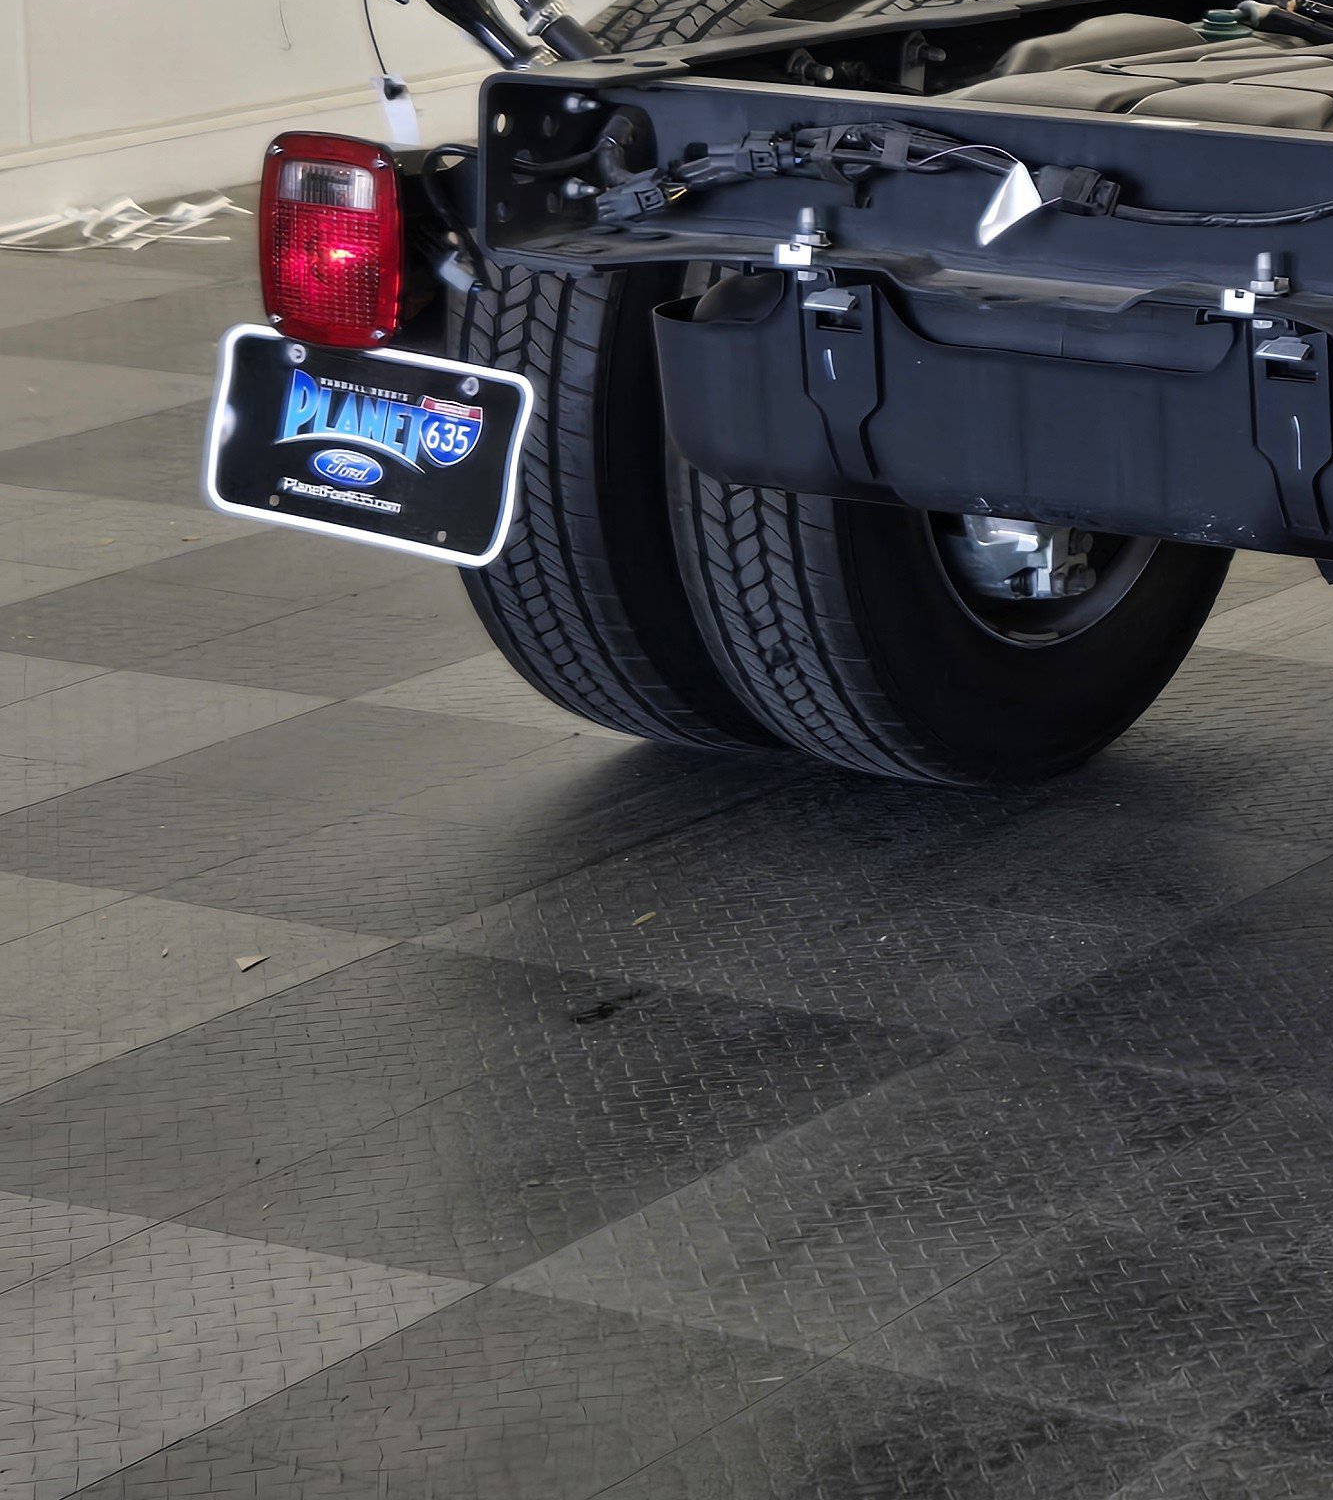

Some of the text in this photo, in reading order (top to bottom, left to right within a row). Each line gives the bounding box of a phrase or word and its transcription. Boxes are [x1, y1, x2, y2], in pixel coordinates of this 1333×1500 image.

[282, 369, 429, 463] PLANET
[426, 421, 471, 454] 635
[325, 455, 370, 484] Ford
